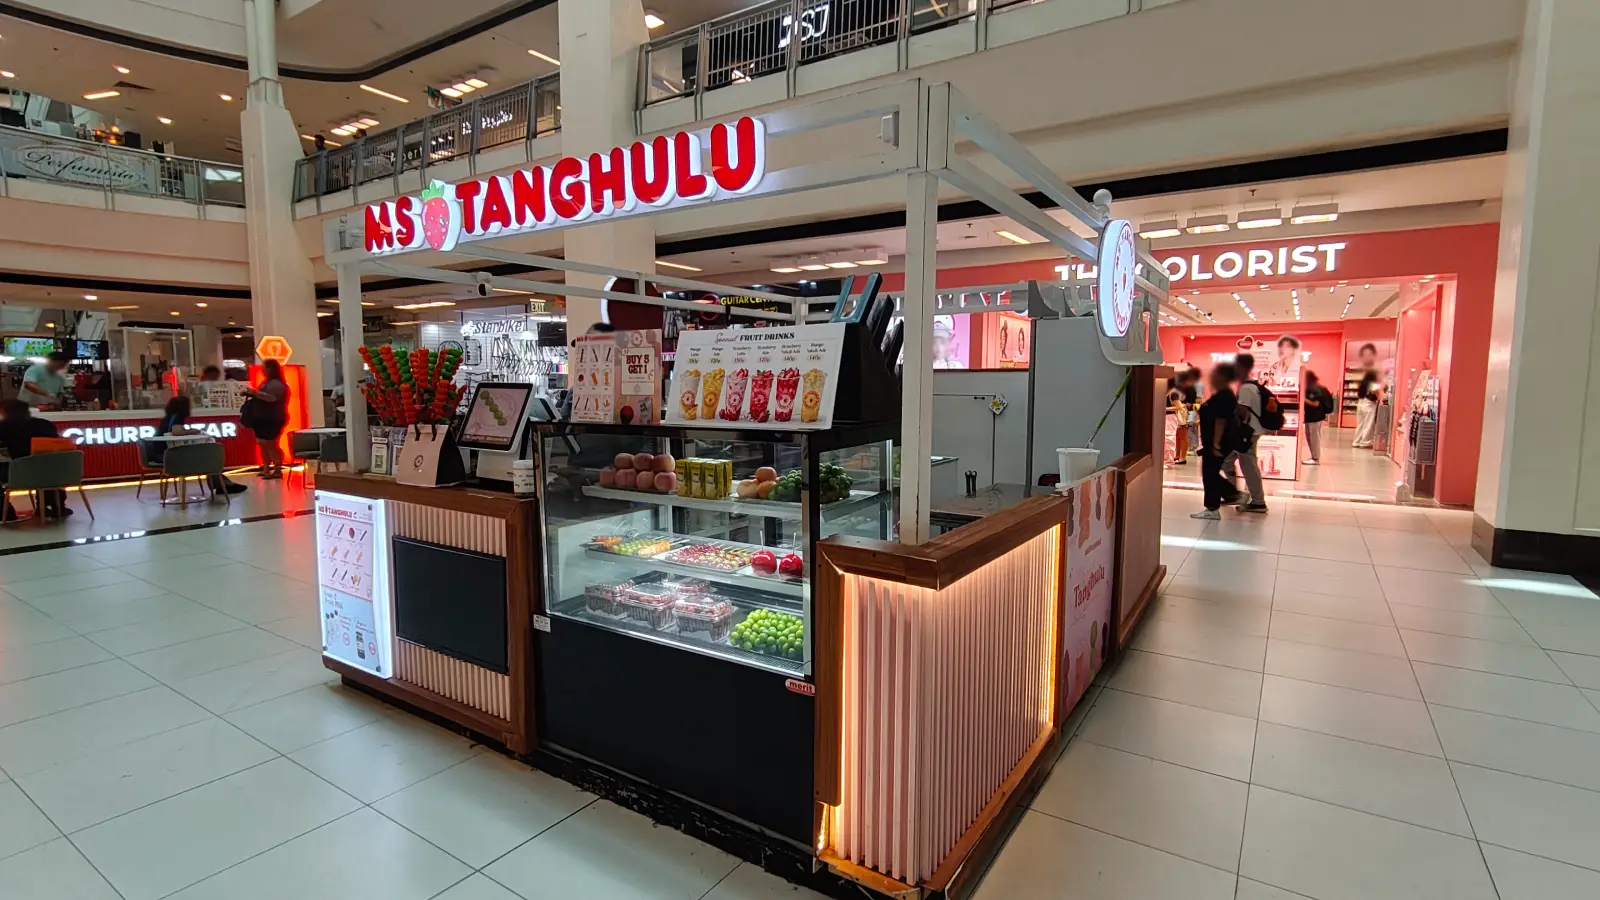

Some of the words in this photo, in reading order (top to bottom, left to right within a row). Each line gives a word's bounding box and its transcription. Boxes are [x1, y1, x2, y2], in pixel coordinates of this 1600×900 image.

[364, 196, 418, 252] MS
[455, 116, 760, 235] TANGHULU
[1054, 263, 1098, 281] TH
[1135, 242, 1347, 281] OLORIST
[720, 296, 749, 305] GUITAR
[531, 302, 544, 312] EXIT
[739, 334, 764, 342] FRUIT
[764, 332, 795, 341] DRINKS
[626, 355, 642, 364] BUY
[628, 365, 643, 374] GET
[1073, 564, 1105, 608] Tanghulu
[789, 681, 813, 693] merit
